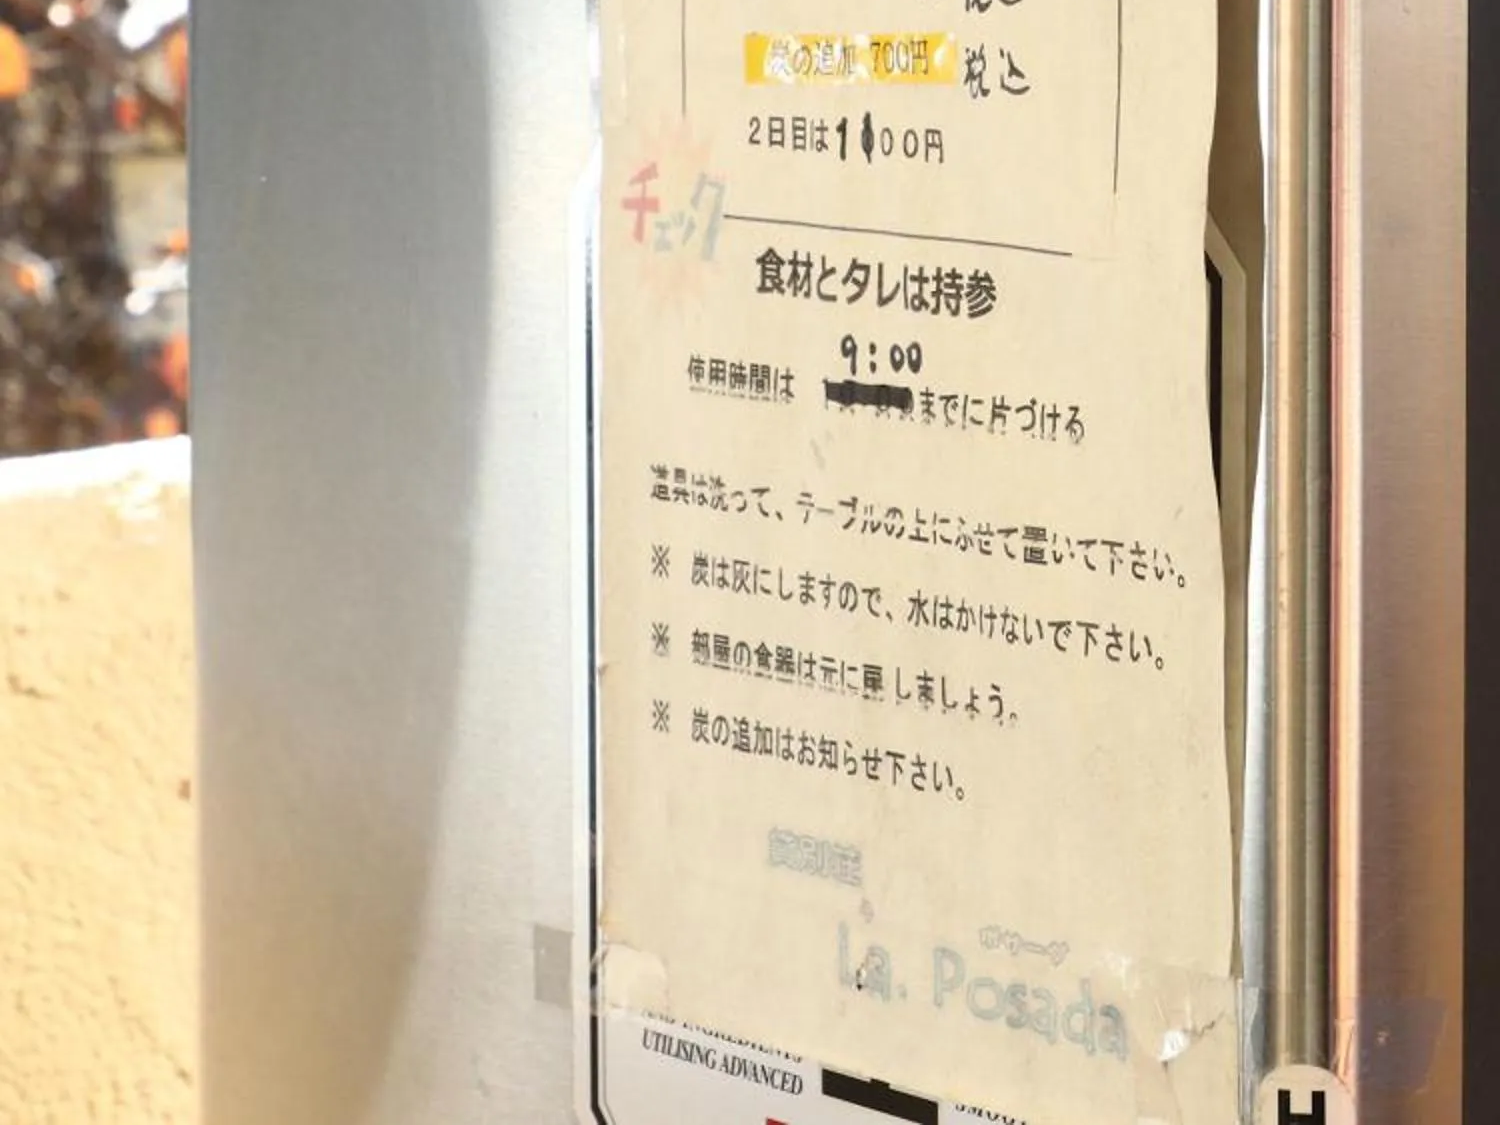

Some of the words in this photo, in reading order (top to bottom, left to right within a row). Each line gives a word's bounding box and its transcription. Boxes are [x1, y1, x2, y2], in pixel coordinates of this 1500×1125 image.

[756, 248, 998, 319] 食材とタレは持参
[841, 335, 923, 376] 9:00
[690, 550, 1165, 672] 炭は灰にしますので、水はかけないで下さい。
[690, 708, 966, 802] 炭の追加はお知らせ下さい。
[931, 946, 1128, 1061] Posada
[642, 1028, 717, 1070] UTILISING
[719, 1054, 803, 1096] ADVANCED
